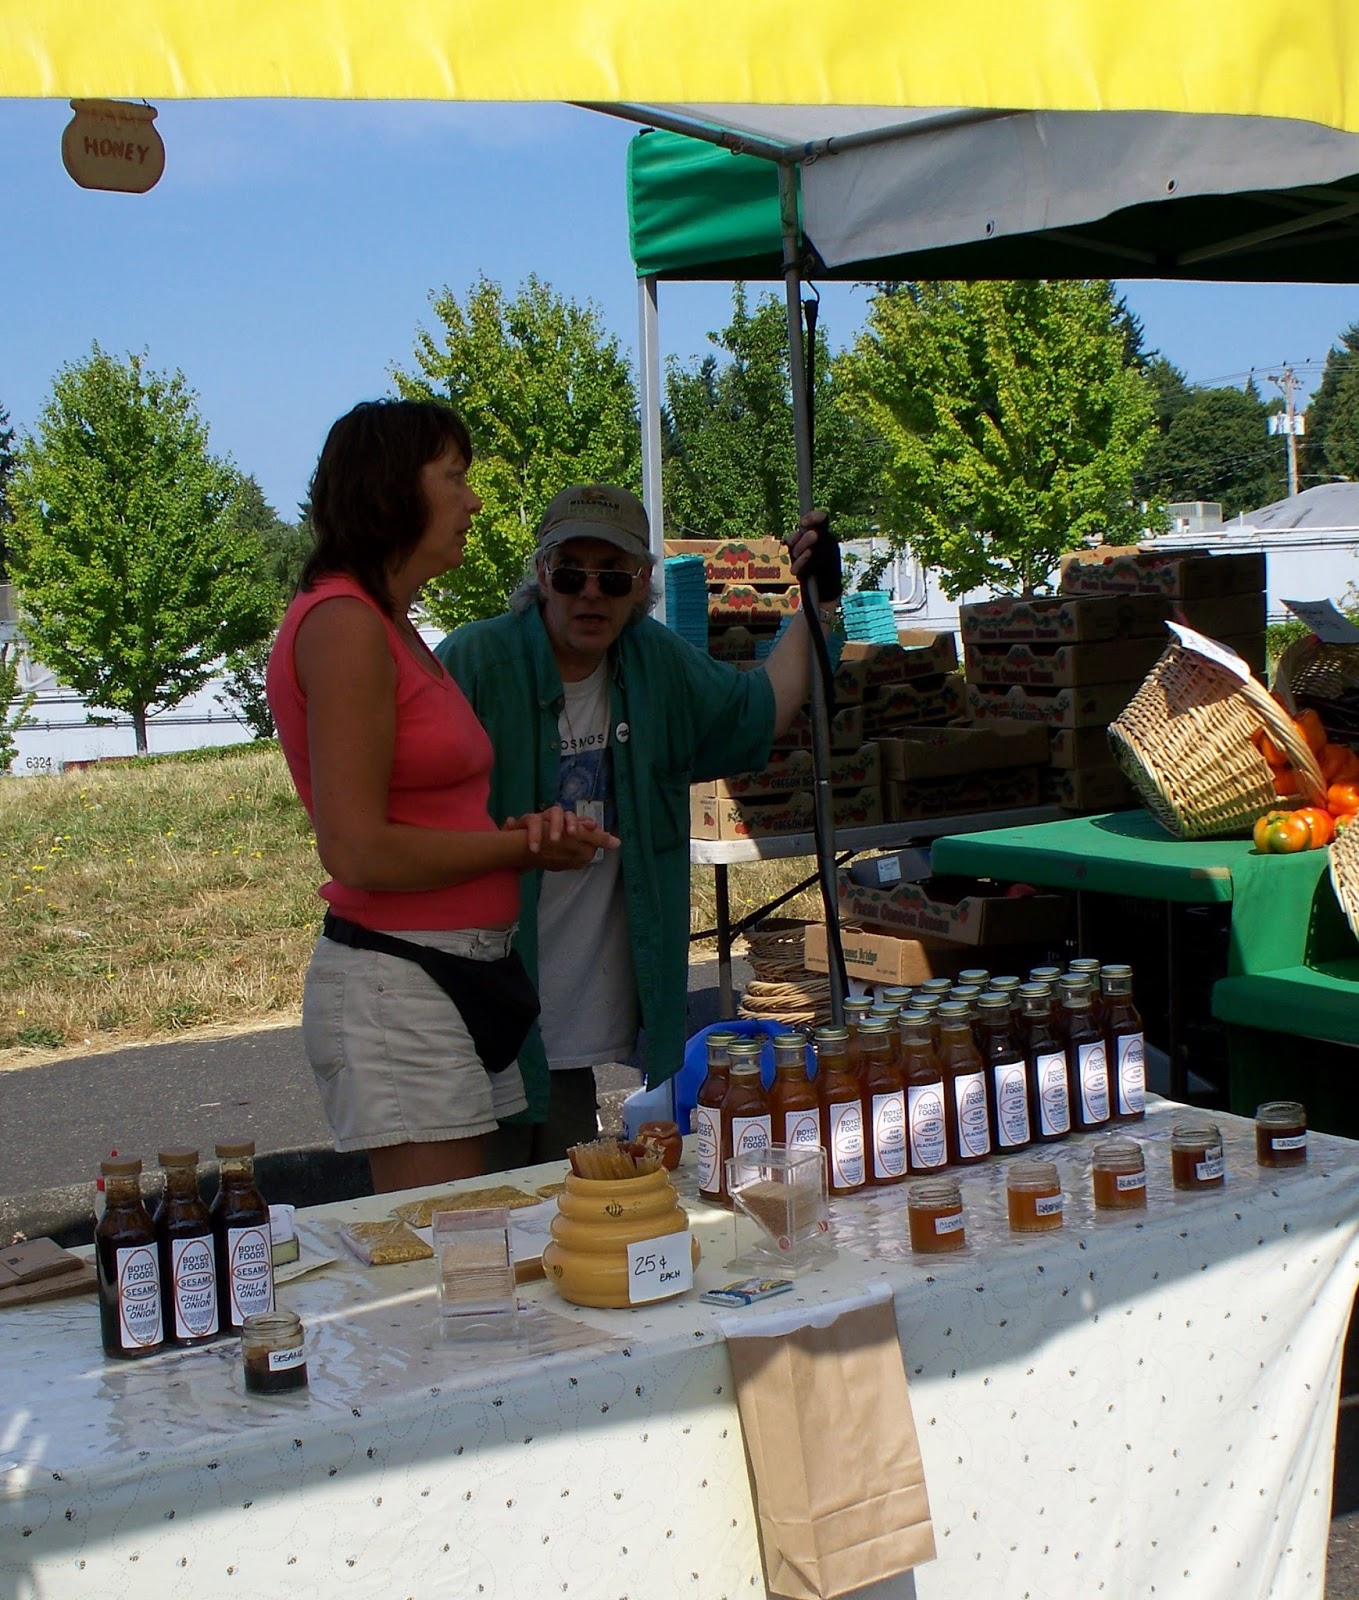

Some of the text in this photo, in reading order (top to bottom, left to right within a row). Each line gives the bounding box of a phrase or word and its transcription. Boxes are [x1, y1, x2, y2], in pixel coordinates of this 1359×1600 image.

[83, 136, 150, 165] HONEY
[560, 733, 605, 750] OSMOS
[26, 756, 51, 769] 6324
[796, 1127, 818, 1136] BOYCO
[742, 1134, 767, 1143] BOYCO
[796, 1135, 817, 1143] FOODS
[742, 1140, 767, 1149] FOODS
[238, 1242, 265, 1253] BOYCO
[182, 1253, 209, 1264] BOYCO
[238, 1250, 265, 1260] FOODS
[127, 1262, 154, 1273] BOYCO
[183, 1262, 209, 1271] FOODS
[236, 1264, 268, 1276] SESAME
[634, 1254, 667, 1276] 25¢
[128, 1270, 154, 1280] FOODS
[659, 1269, 681, 1283] EACH
[181, 1275, 213, 1287] SESAME
[126, 1285, 157, 1296] SESAME
[236, 1282, 259, 1292] CHILI
[180, 1293, 203, 1303] CHILI
[239, 1288, 267, 1298] ONION
[125, 1302, 149, 1312] CHILI
[184, 1299, 211, 1309] ONION
[130, 1309, 156, 1319] ONION
